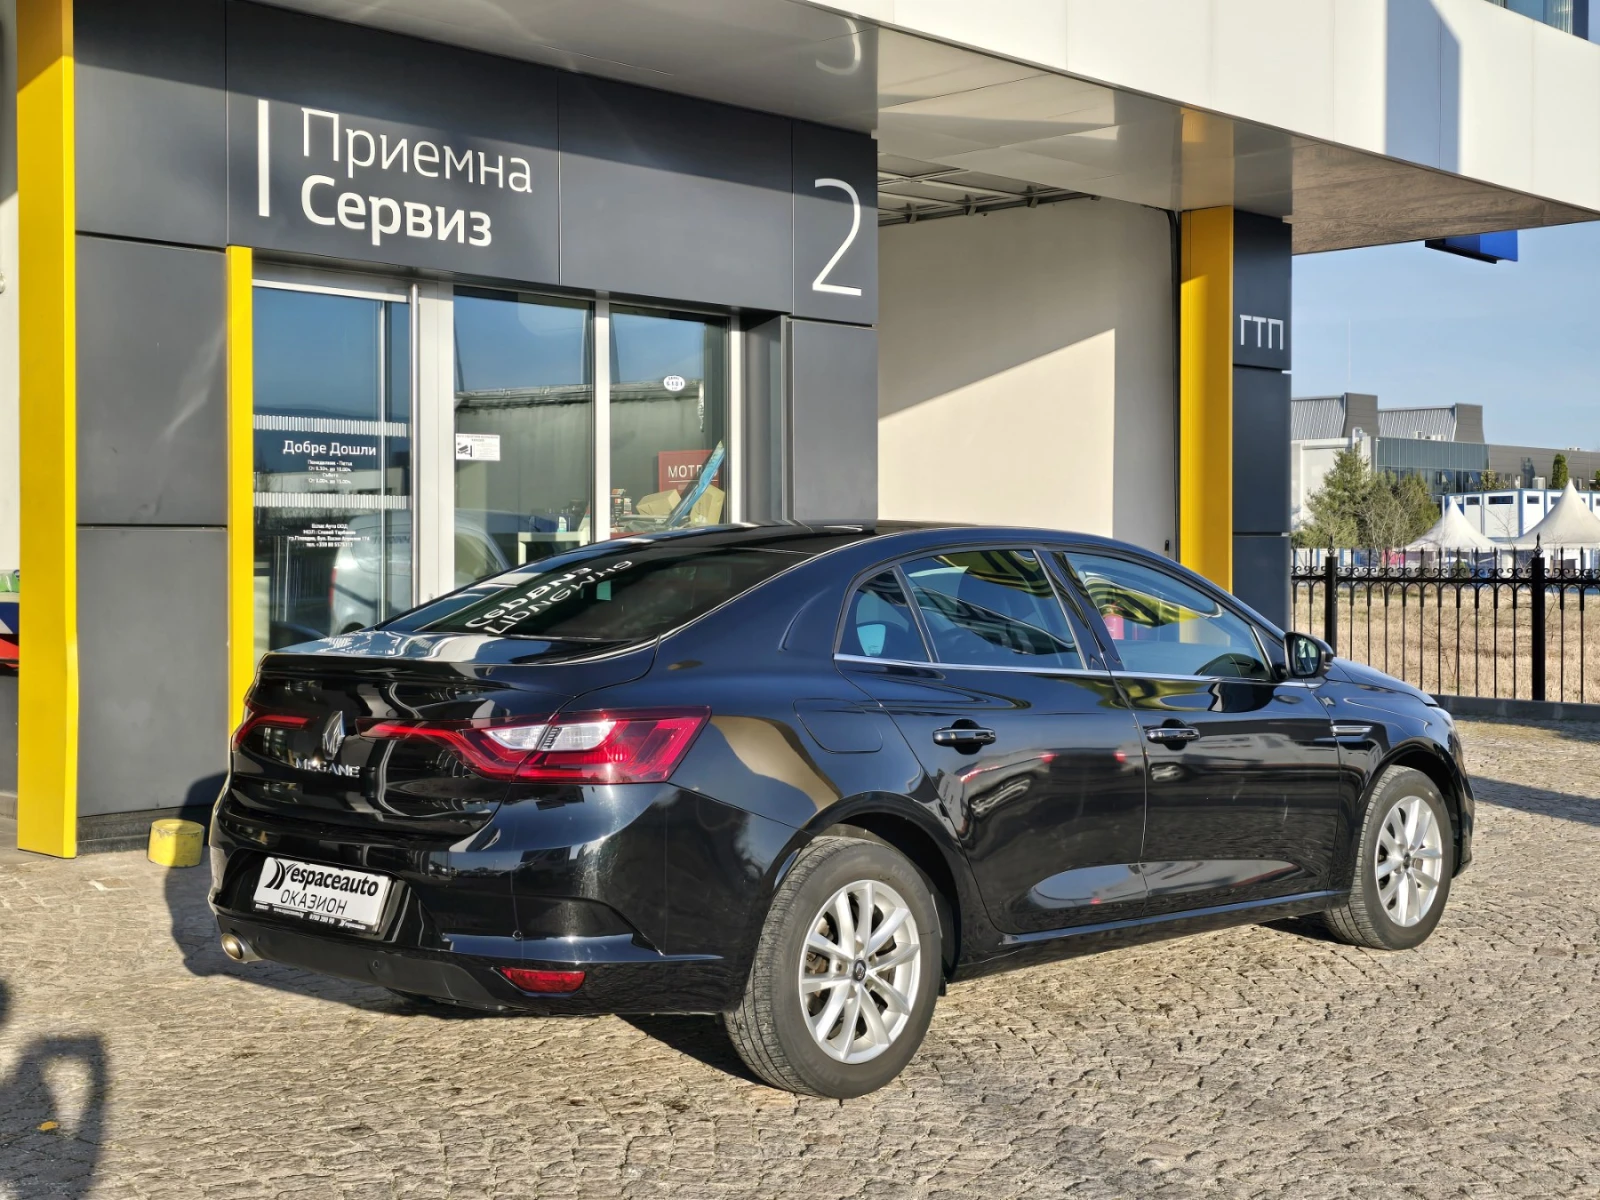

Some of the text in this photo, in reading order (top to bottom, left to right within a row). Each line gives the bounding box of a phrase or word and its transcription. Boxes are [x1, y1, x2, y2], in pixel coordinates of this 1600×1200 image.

[301, 106, 533, 194] Приемна
[300, 173, 493, 247] Сервиз
[811, 178, 863, 297] 2
[1239, 313, 1284, 351] ГТП
[282, 439, 377, 457] Добре Дошли
[290, 866, 379, 897] espaceauto
[280, 889, 348, 915] ОКАЗИОН
